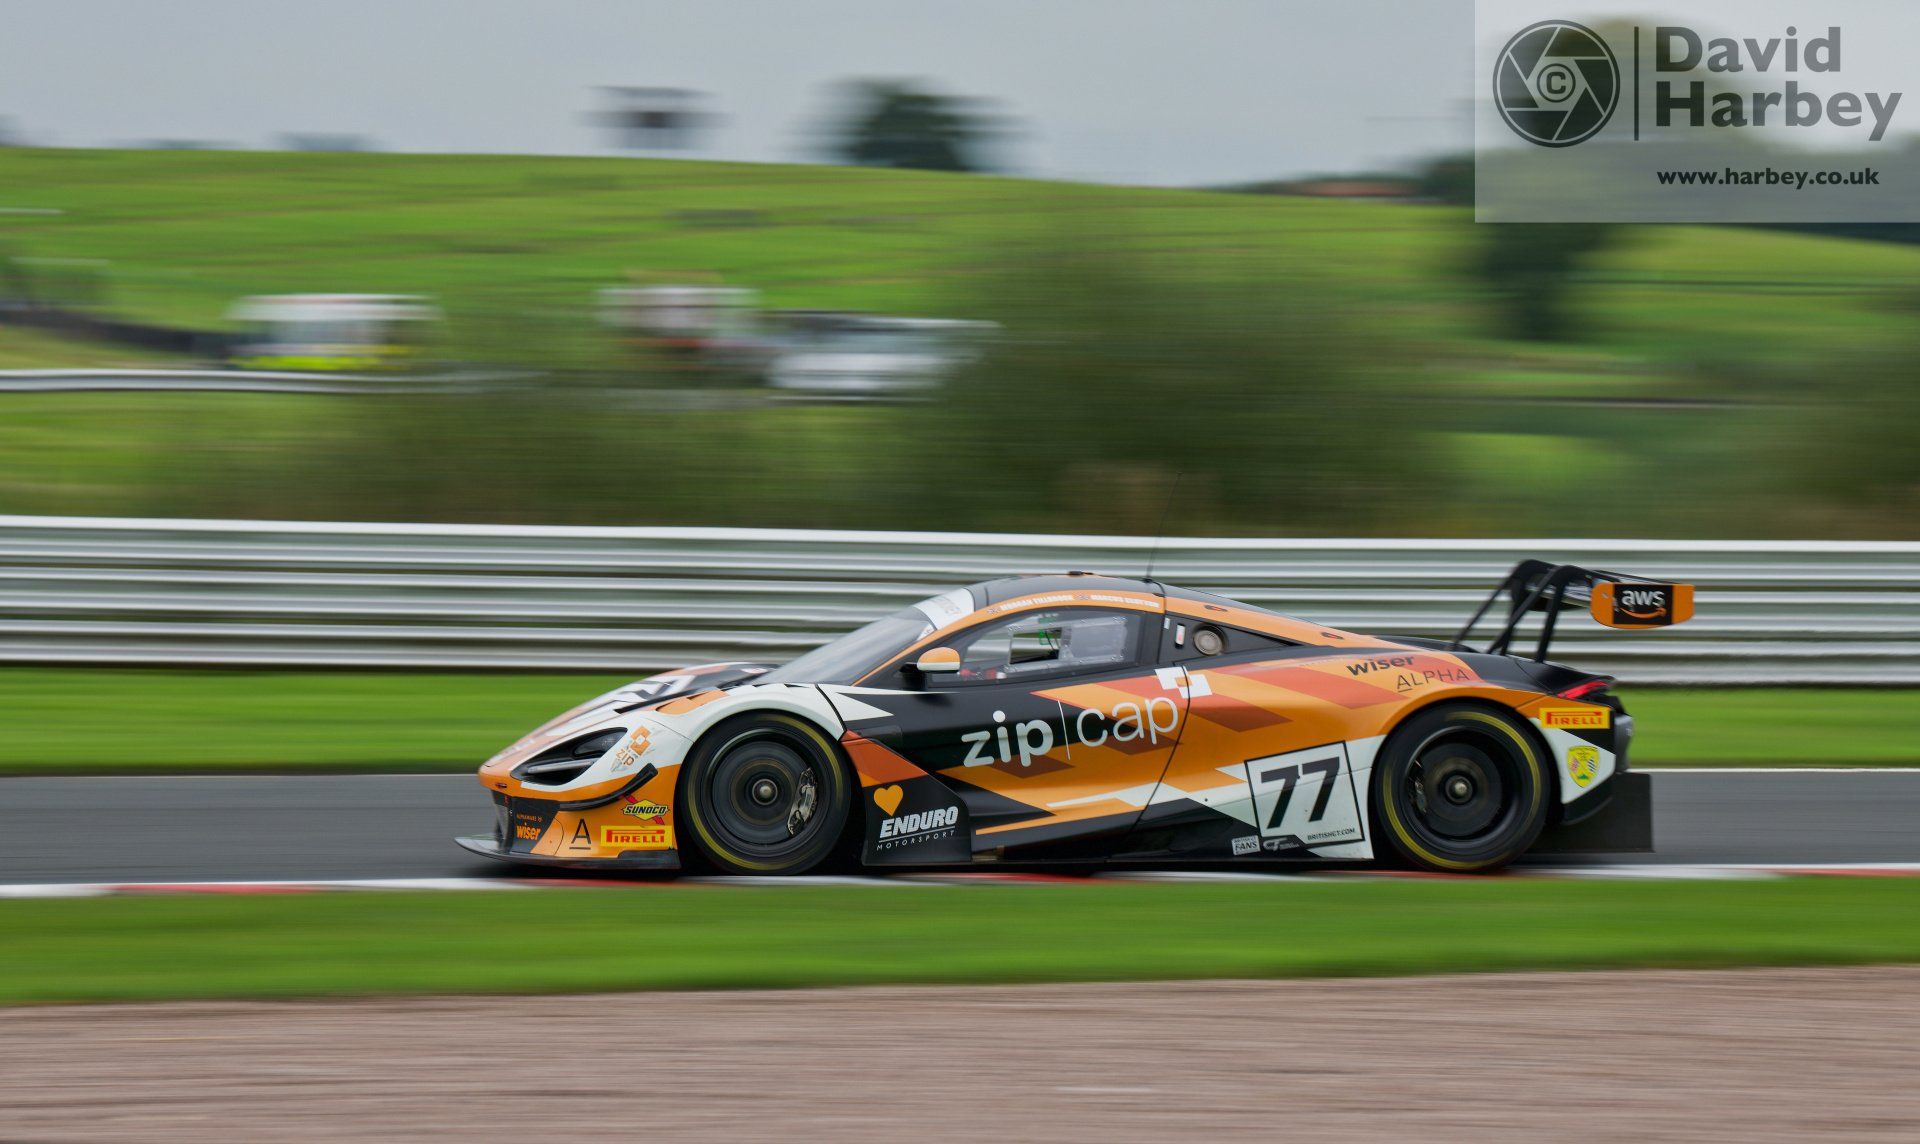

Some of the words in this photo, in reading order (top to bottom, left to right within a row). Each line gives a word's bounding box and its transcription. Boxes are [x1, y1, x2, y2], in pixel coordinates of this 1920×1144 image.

[1621, 589, 1666, 606] aws
[1346, 655, 1415, 677] wiser
[1396, 667, 1471, 691] ALPHA
[1545, 710, 1604, 726] PIRELLI
[960, 709, 1054, 768] zip
[1076, 696, 1180, 748] cap
[615, 749, 635, 767] zip
[1260, 756, 1340, 830] 77
[624, 804, 667, 816] SUNOCO
[879, 805, 959, 839] ENDURO
[516, 824, 541, 841] wiser
[570, 818, 592, 850] A
[606, 828, 666, 844] PIRELLI
[876, 829, 956, 852] MOTORSPORT
[1234, 841, 1258, 852] FANS
